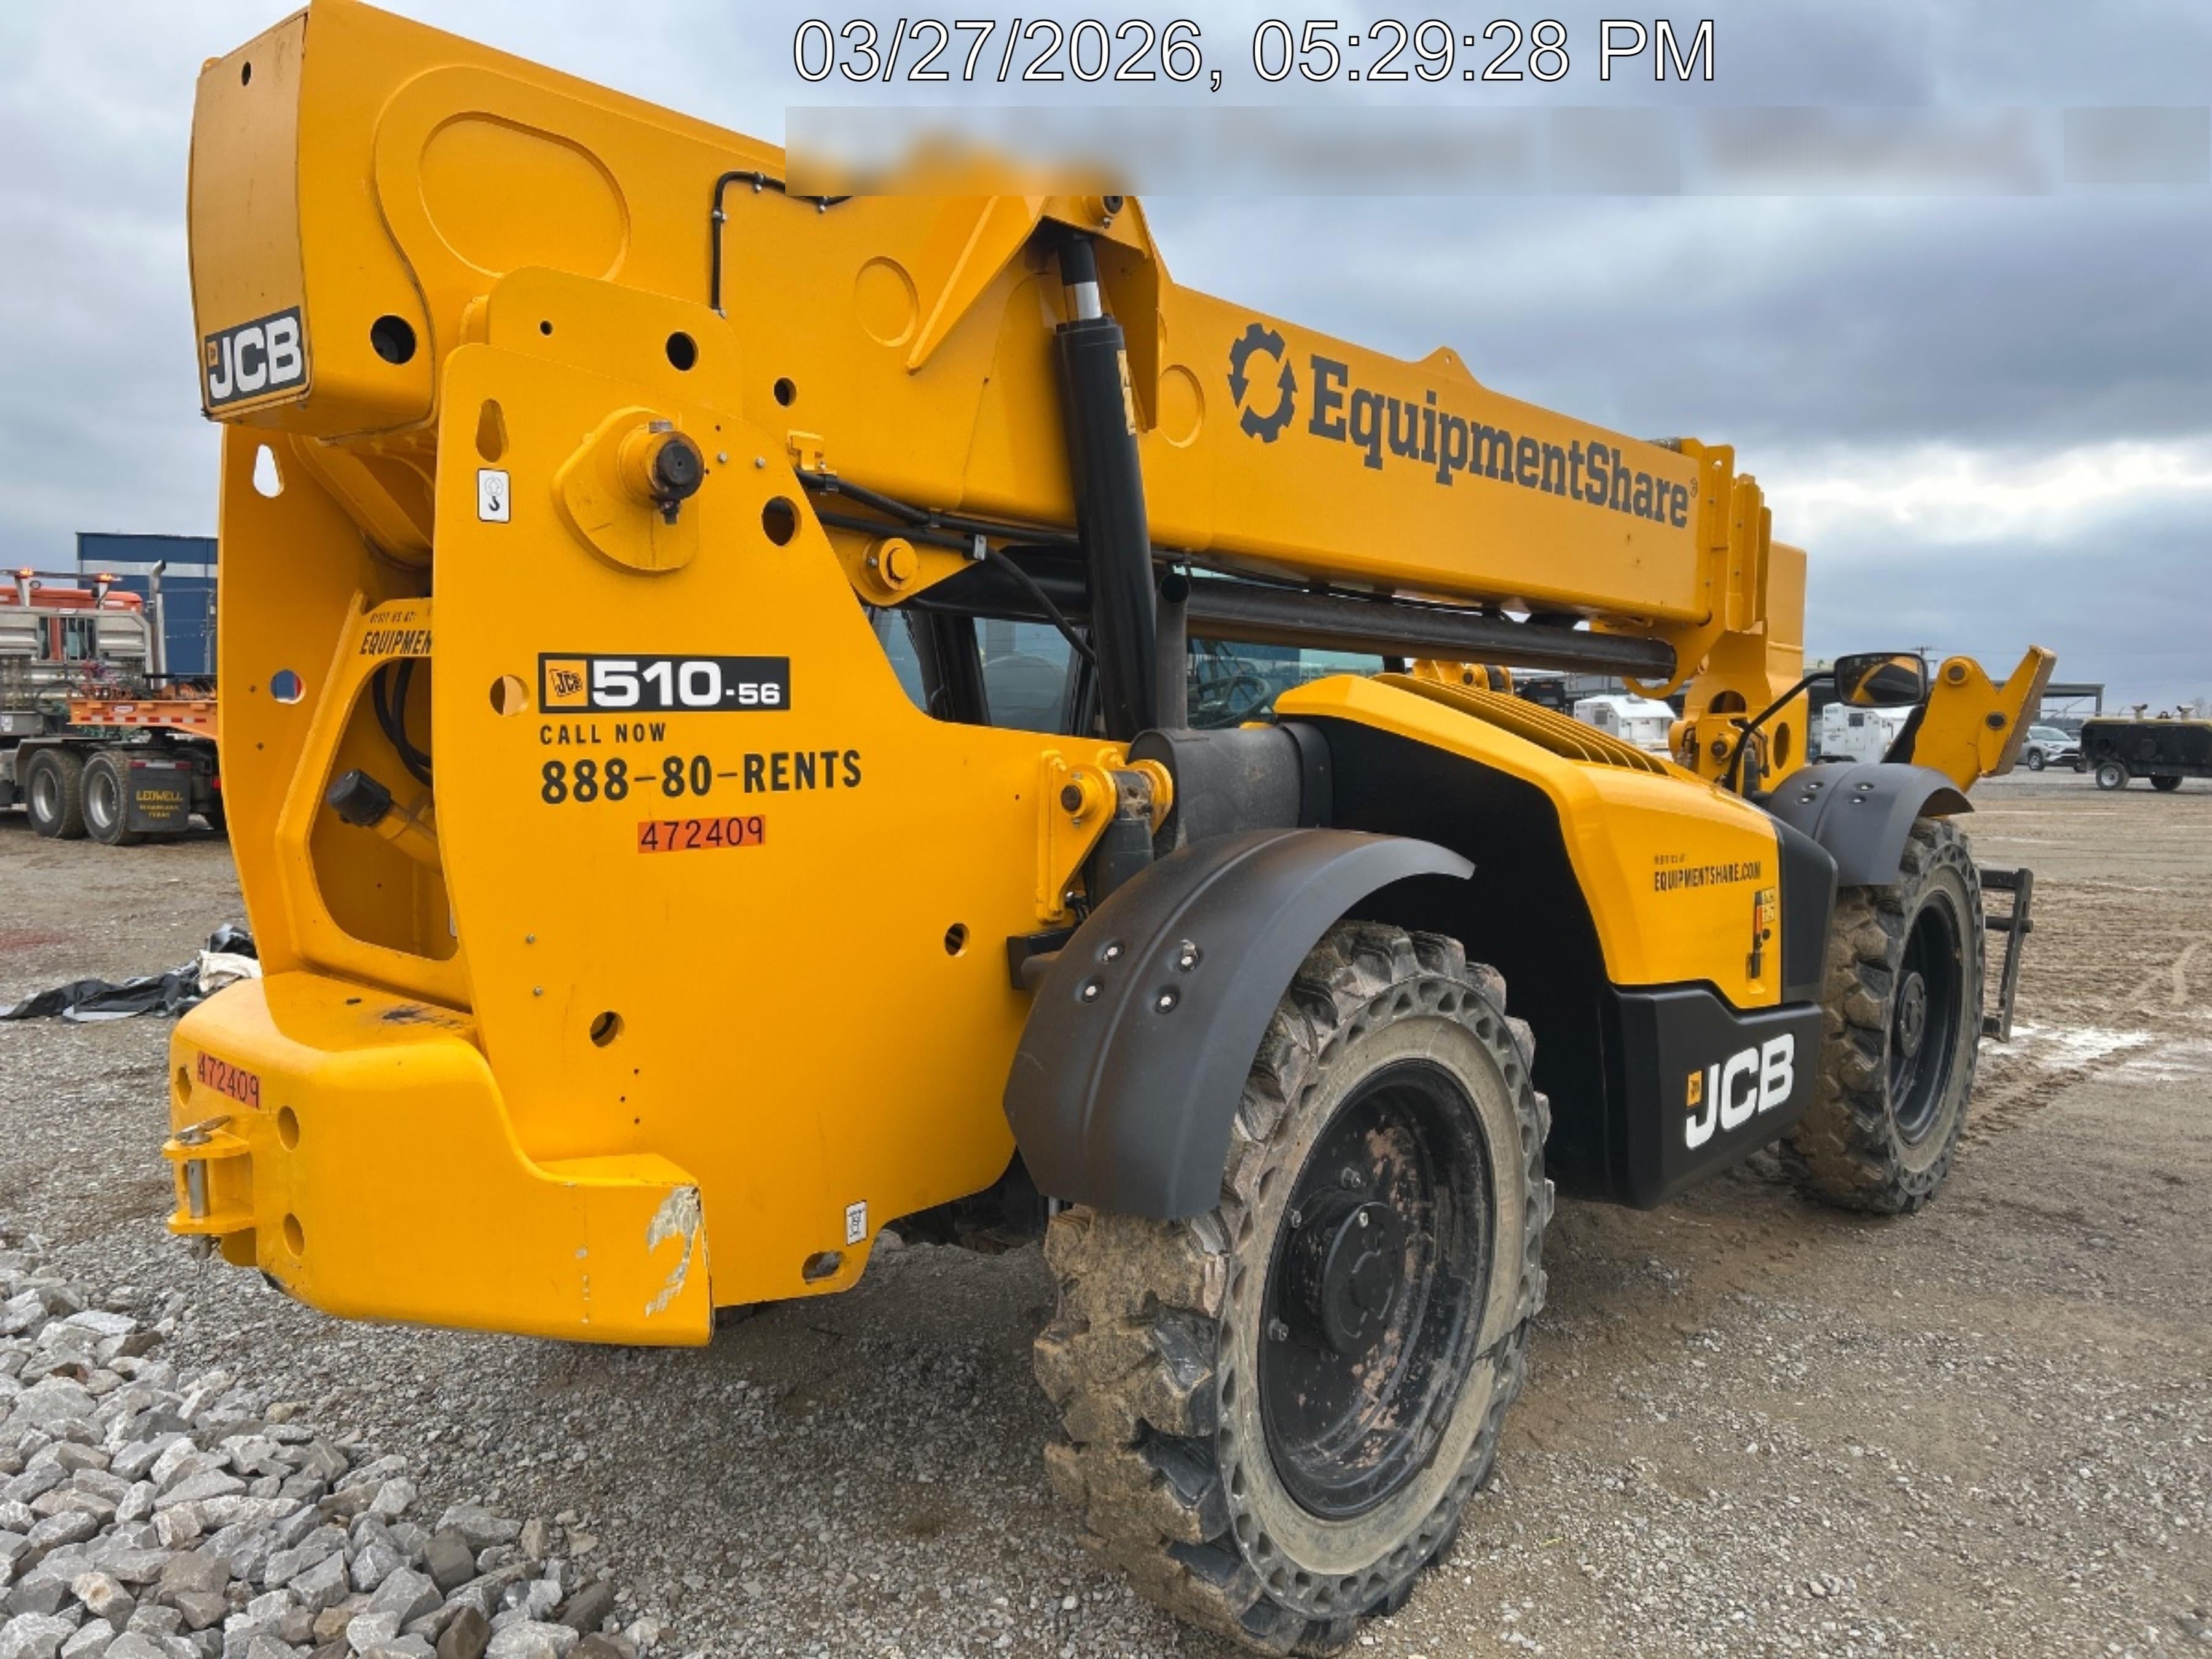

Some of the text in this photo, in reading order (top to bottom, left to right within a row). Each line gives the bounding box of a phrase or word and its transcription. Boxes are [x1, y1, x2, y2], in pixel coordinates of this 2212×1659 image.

[210, 316, 302, 399] JCB
[1308, 353, 1688, 528] EquipmentShare
[592, 659, 781, 707] 510-56
[539, 722, 666, 745] CALL NOW
[541, 749, 862, 805] 888-80-RENTS
[641, 816, 763, 851] 472409
[1654, 861, 1761, 892] EQUIPMENTSHARE.COM
[198, 1053, 259, 1108] 472409
[1686, 1033, 1794, 1149] JCB
